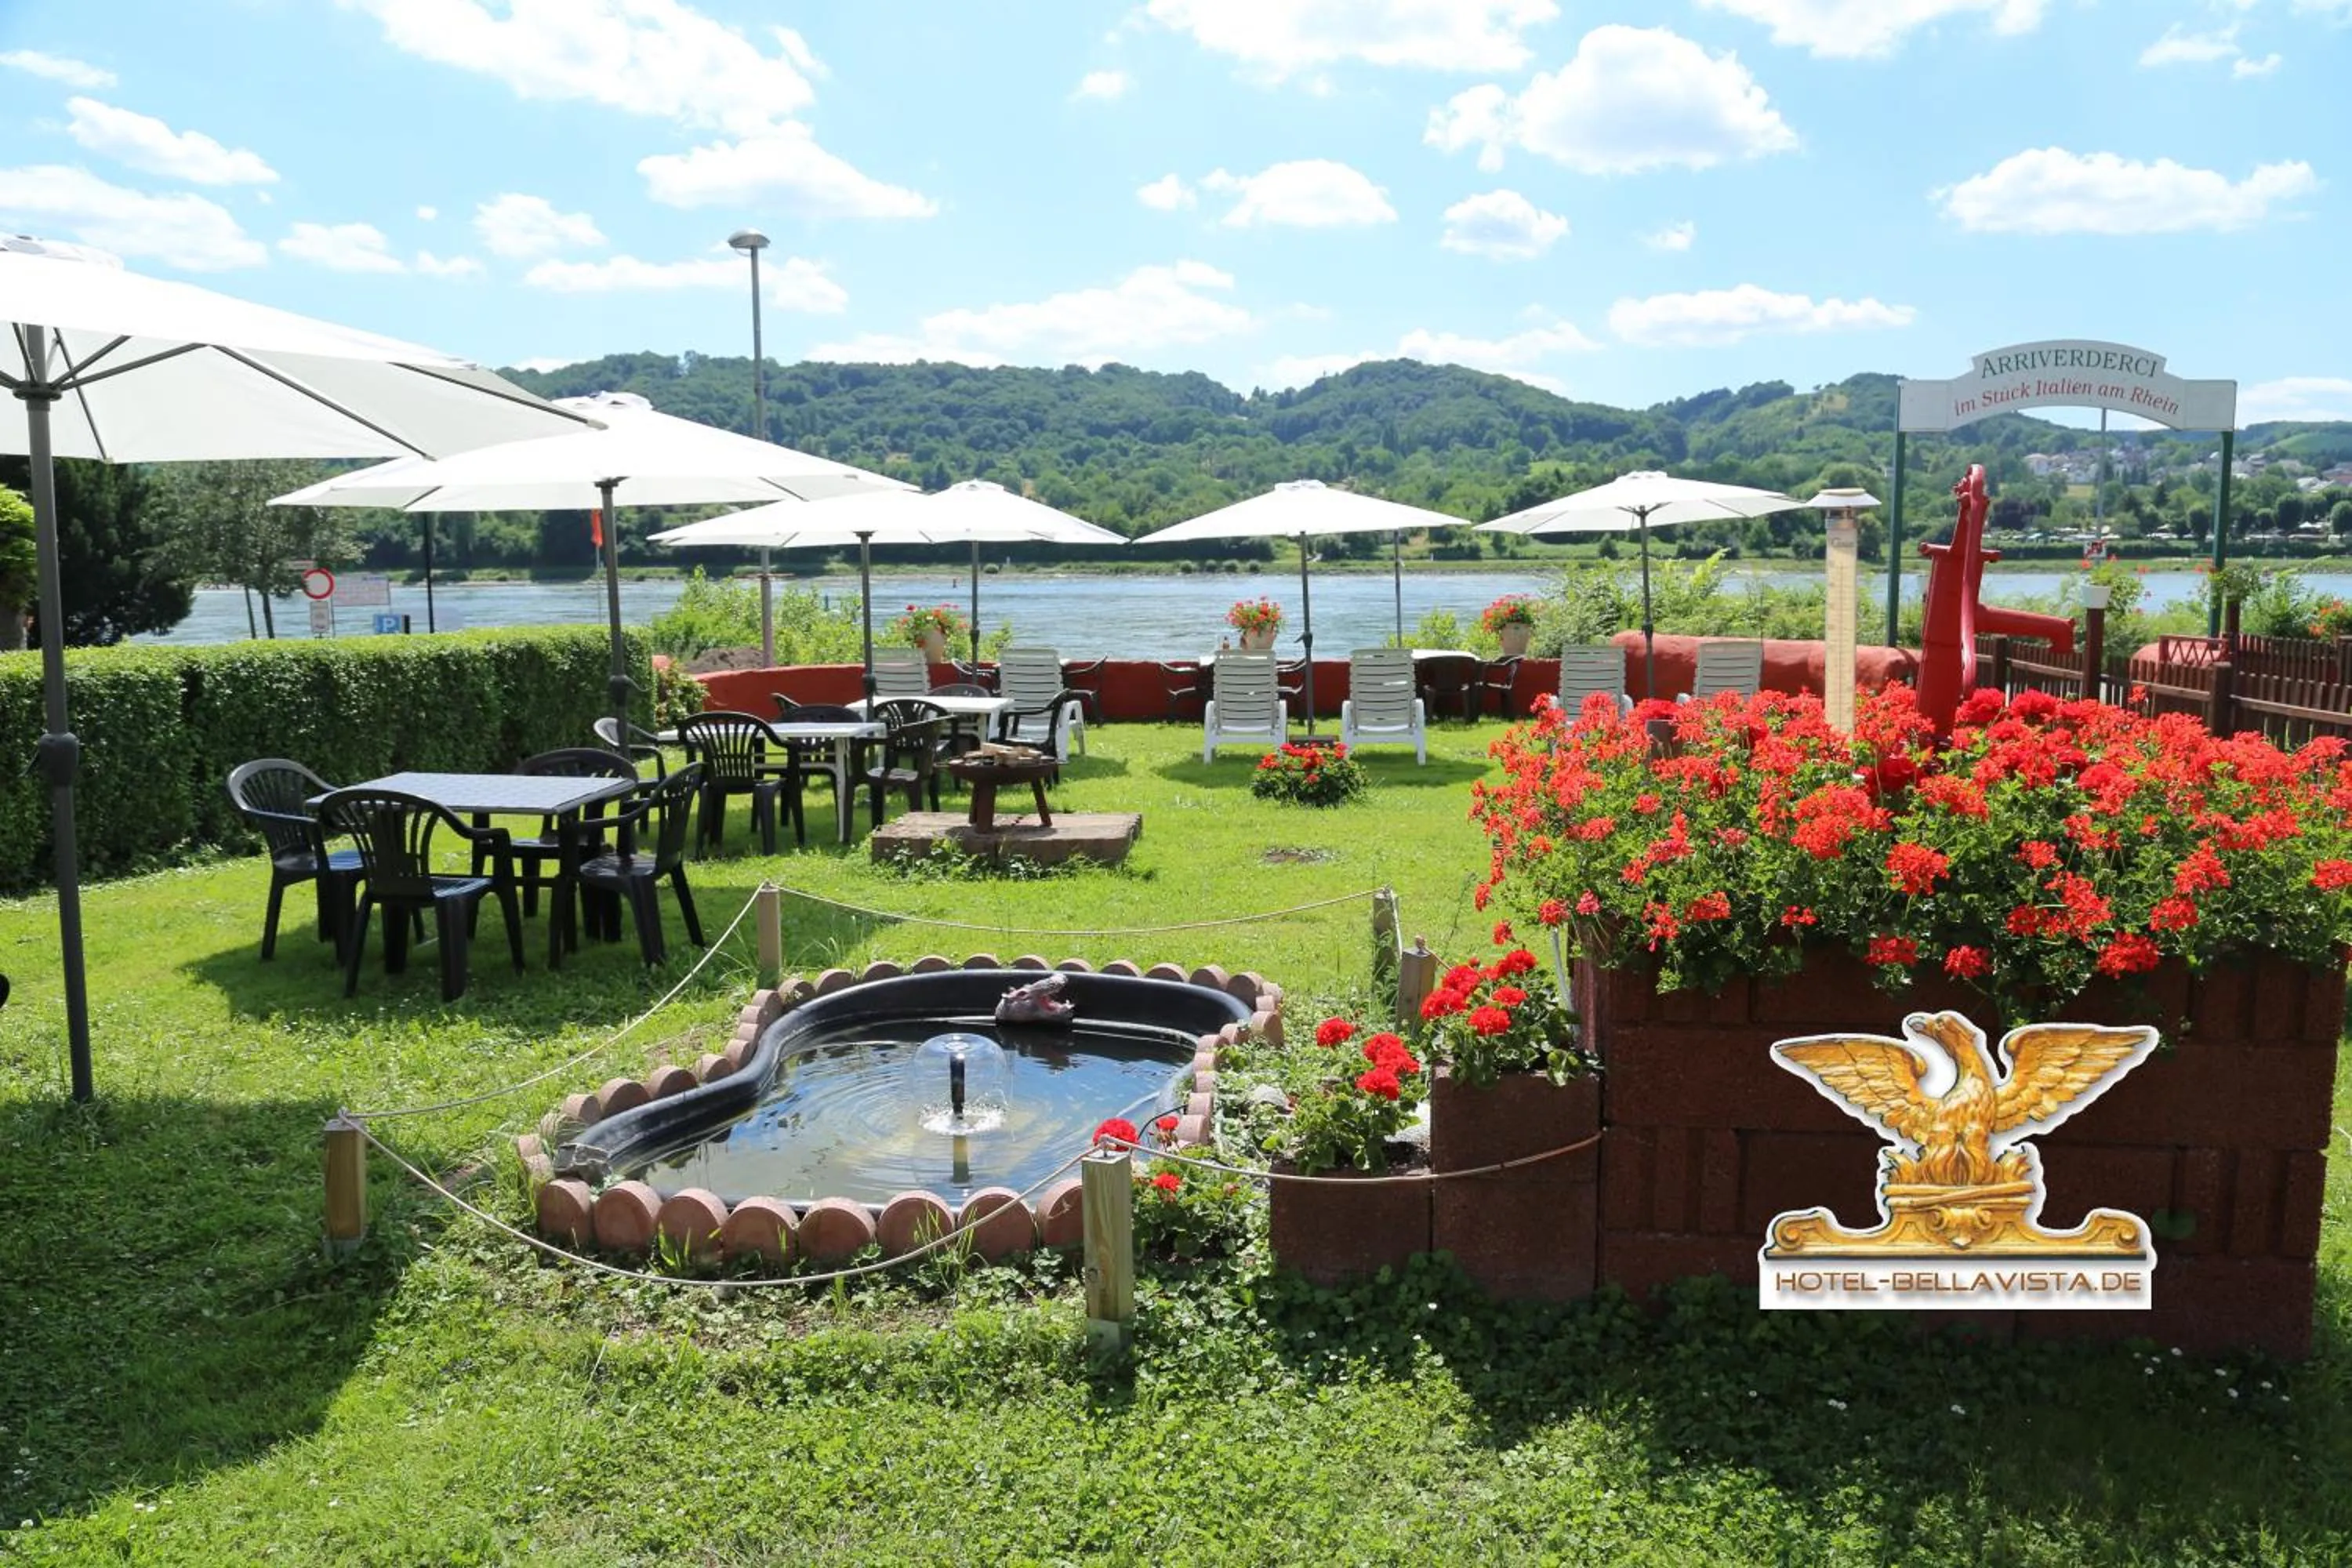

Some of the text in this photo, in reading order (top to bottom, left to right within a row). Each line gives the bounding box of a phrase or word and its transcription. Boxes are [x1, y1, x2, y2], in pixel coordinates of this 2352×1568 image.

[1981, 348, 2158, 379] ARRIVERDERCI
[2035, 379, 2092, 397] Italien
[2097, 385, 2125, 401] am
[2130, 387, 2180, 416] Rhein
[383, 618, 397, 633] P
